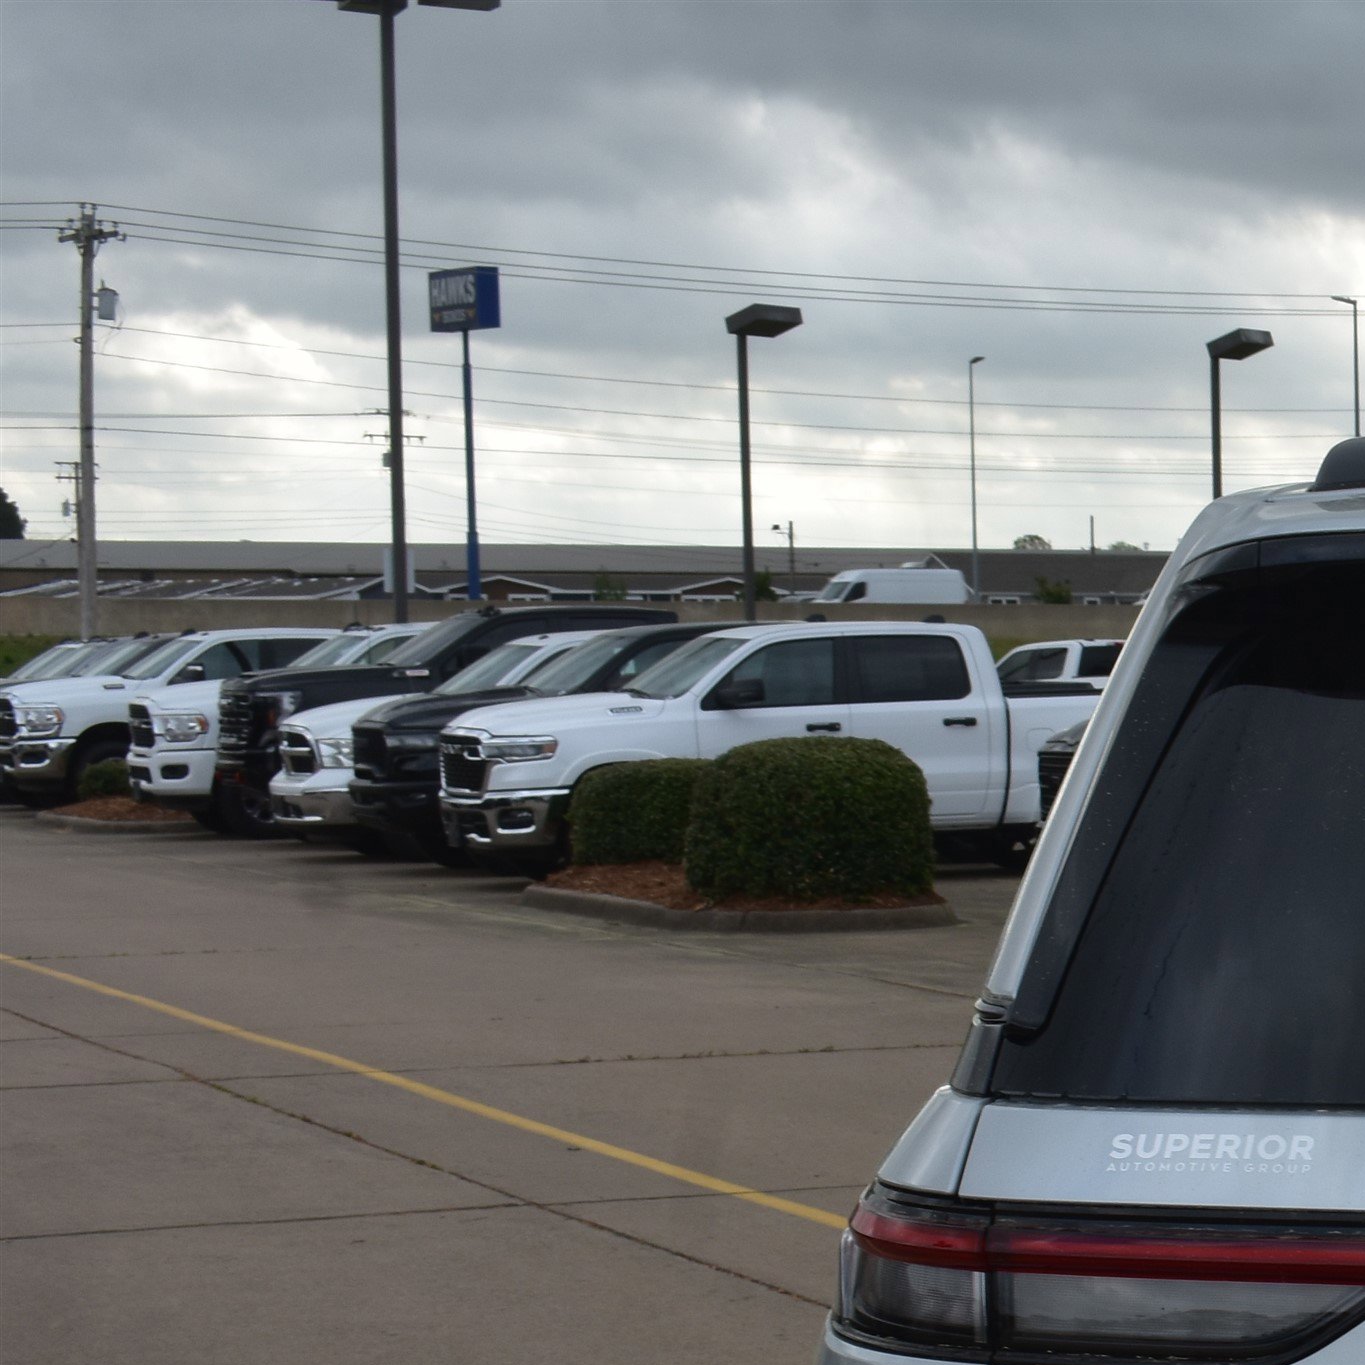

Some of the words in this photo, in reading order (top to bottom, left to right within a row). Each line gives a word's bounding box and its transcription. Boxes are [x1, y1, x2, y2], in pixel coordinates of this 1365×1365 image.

[1109, 1133, 1315, 1161] SUPERIOR
[1105, 1161, 1232, 1173] AUTOMOTIVE
[1243, 1162, 1312, 1174] GROUP
